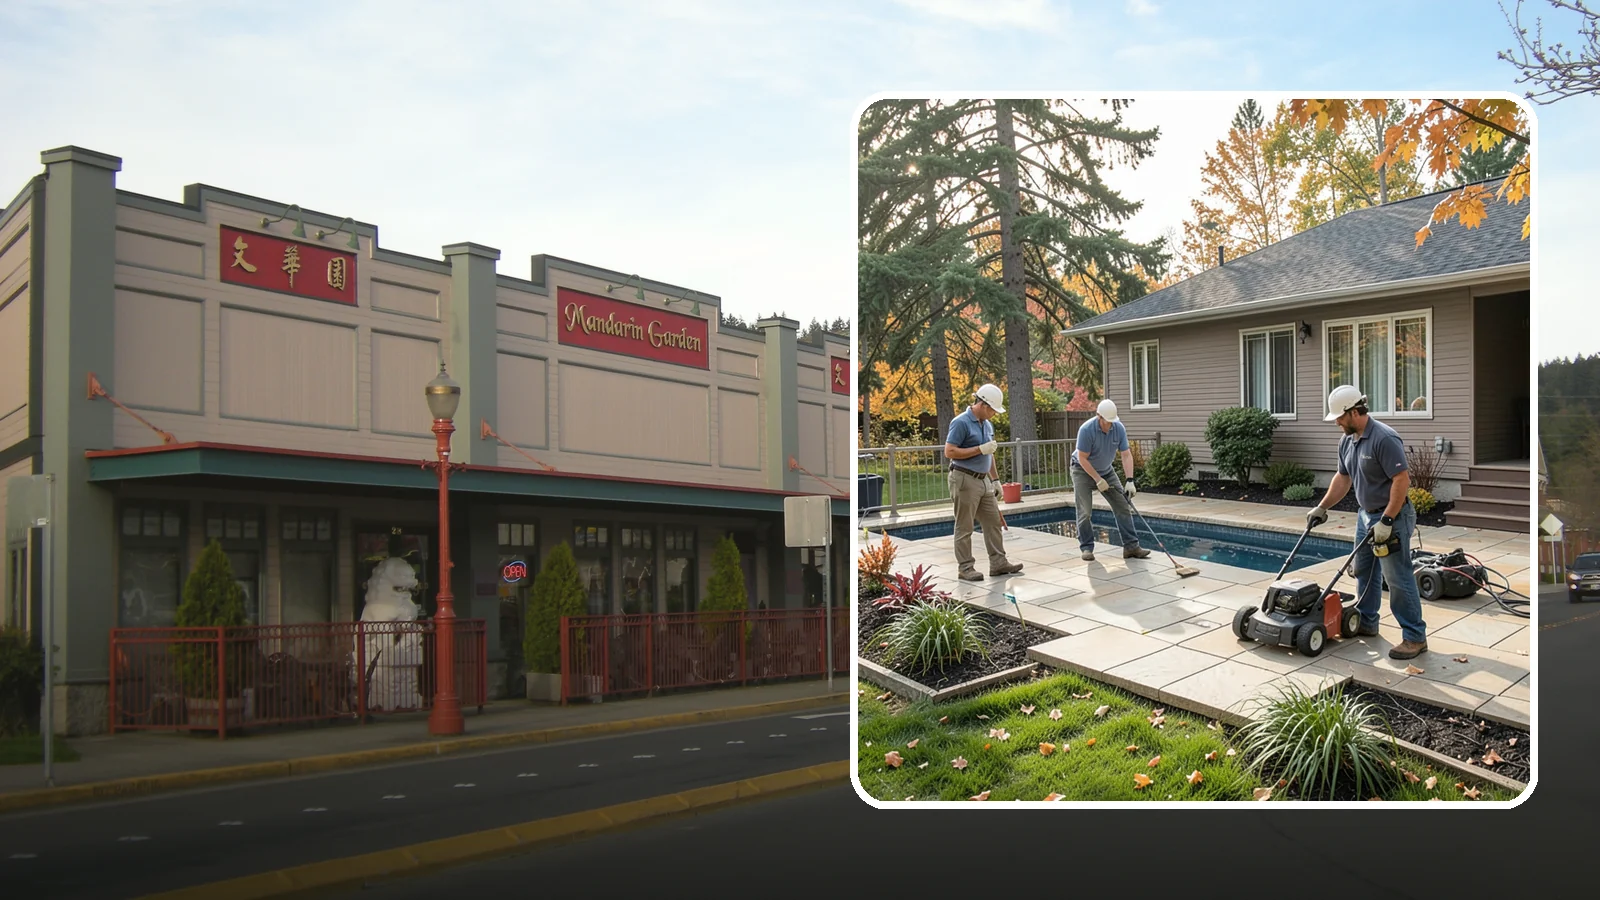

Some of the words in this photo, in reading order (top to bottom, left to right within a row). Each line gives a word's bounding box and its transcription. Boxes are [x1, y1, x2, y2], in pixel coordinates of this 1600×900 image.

[564, 302, 643, 340] Mandarin
[648, 320, 701, 352] Garden
[503, 565, 526, 578] OPEN
